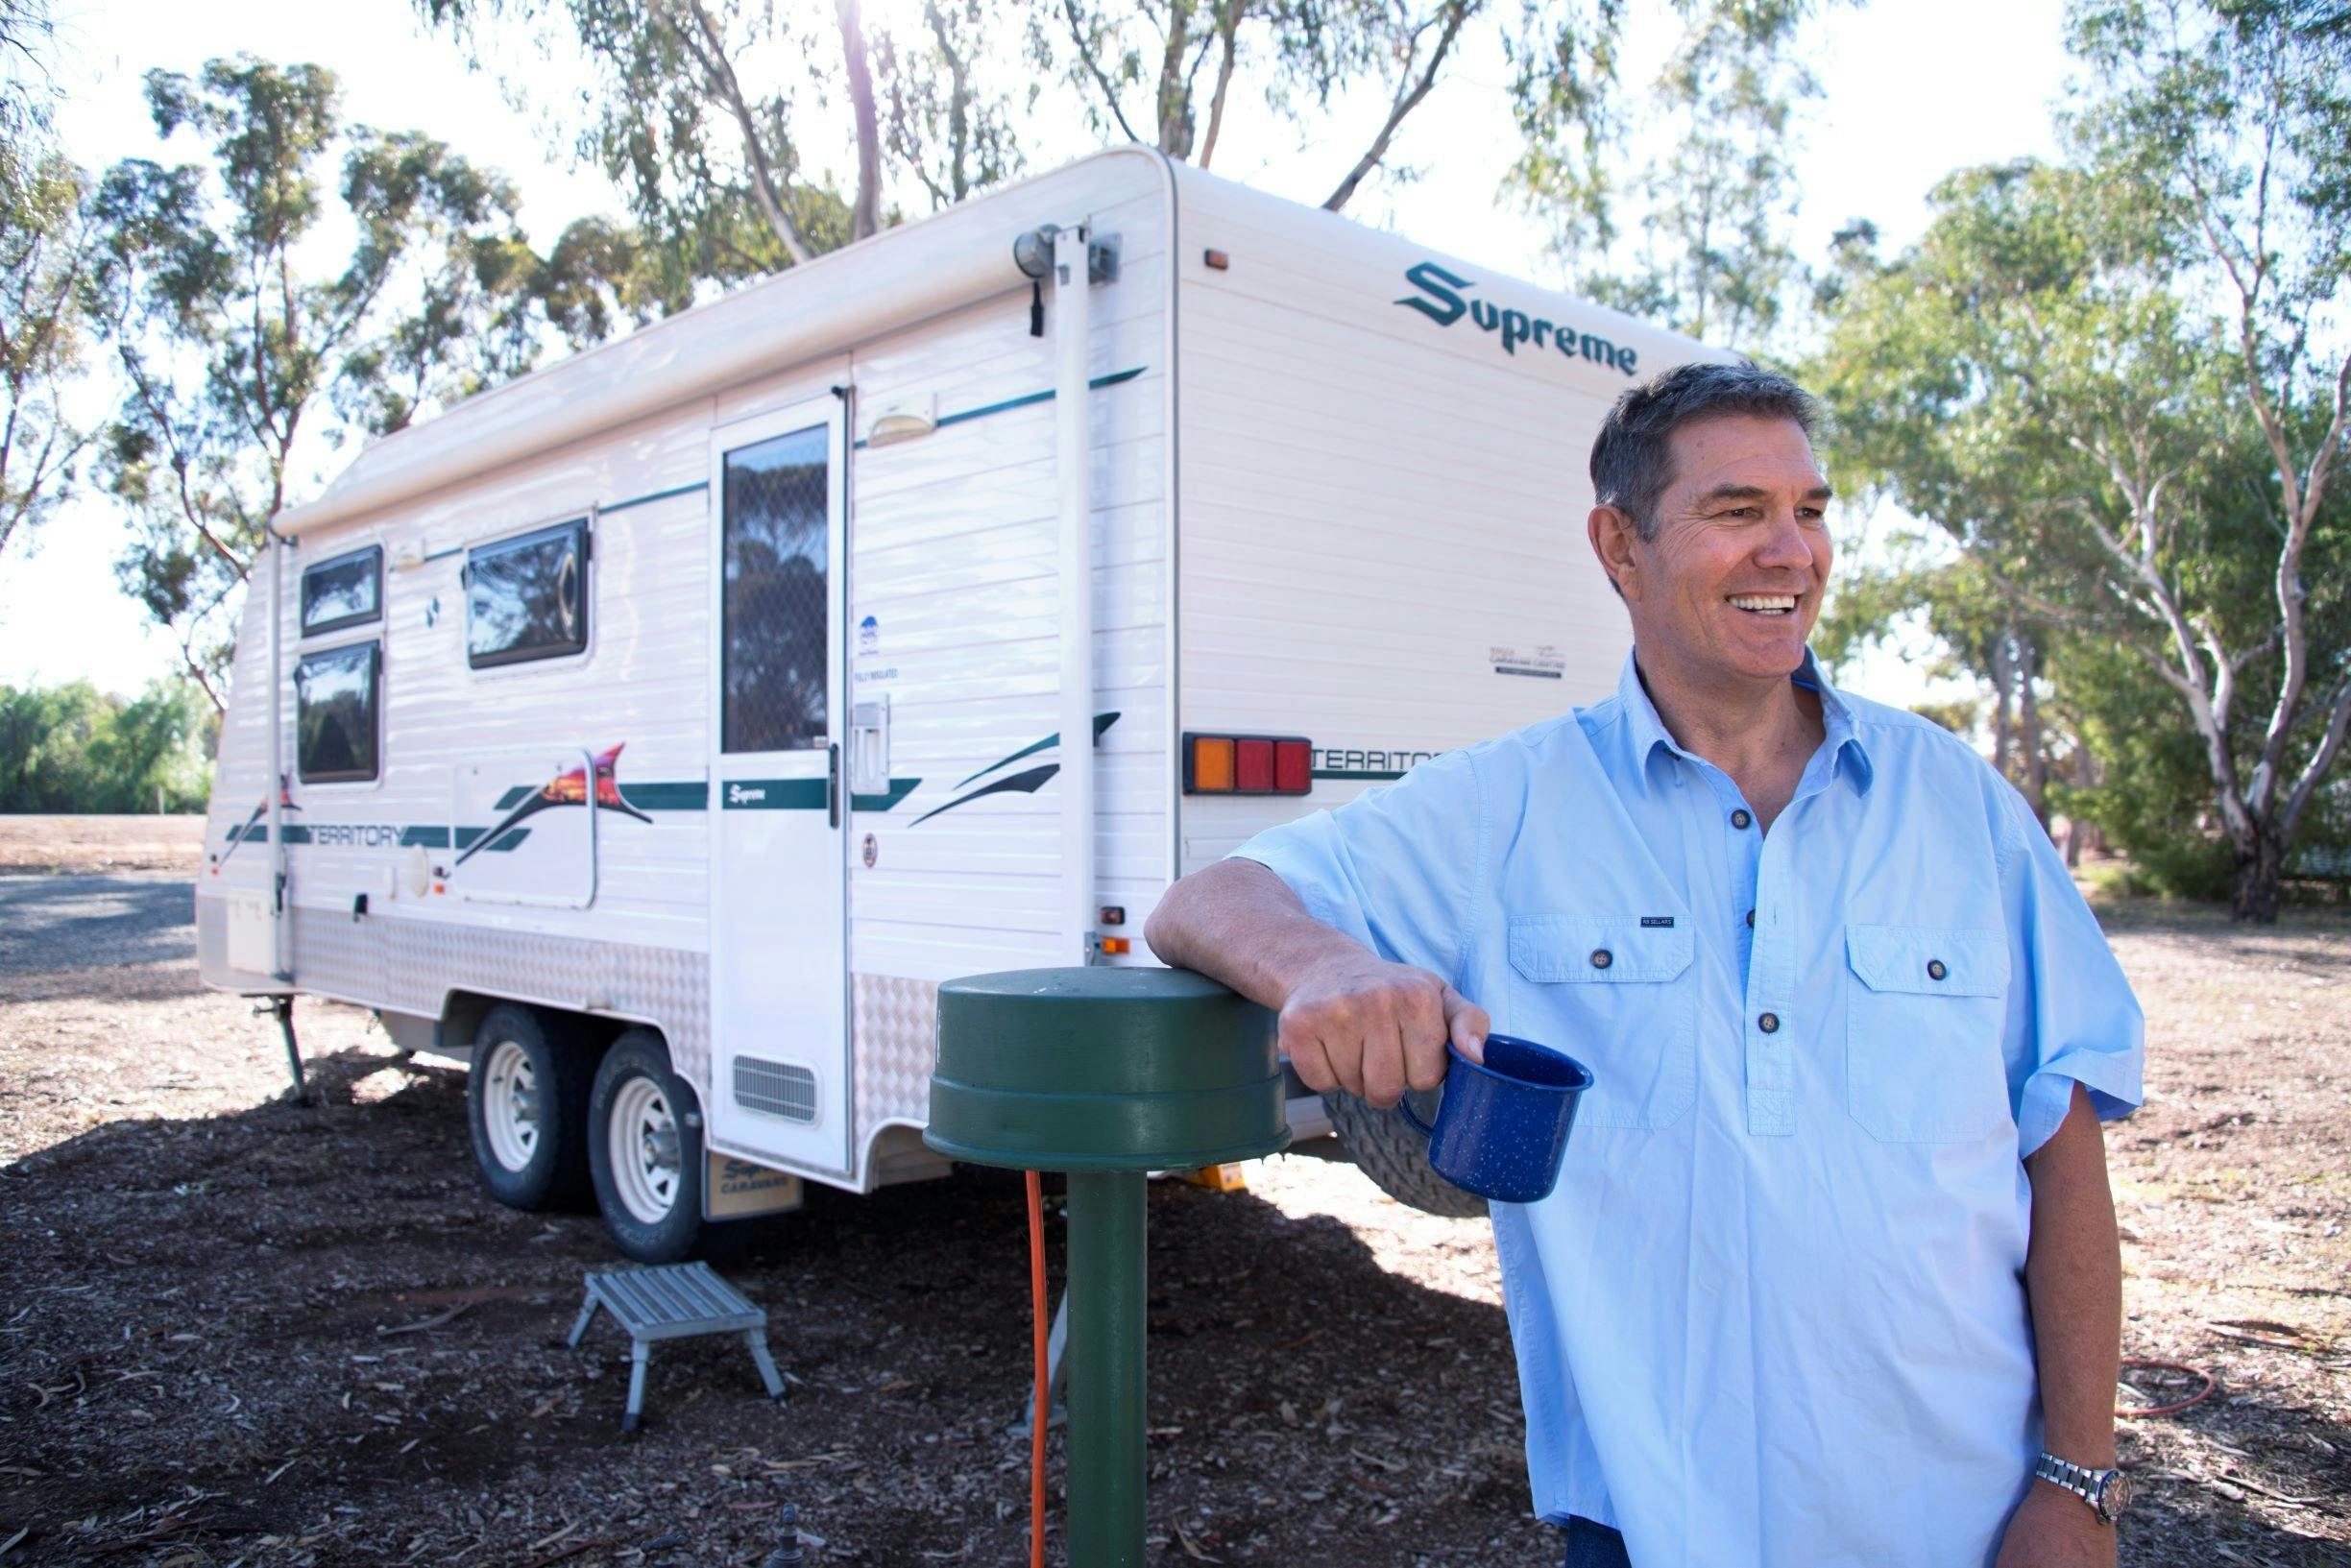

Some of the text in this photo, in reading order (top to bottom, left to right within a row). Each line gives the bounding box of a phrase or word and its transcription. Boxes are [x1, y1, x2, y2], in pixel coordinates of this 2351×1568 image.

[1393, 261, 1637, 376] Supreme
[1311, 748, 1443, 771] TERRITO
[308, 825, 401, 846] TERRITORY
